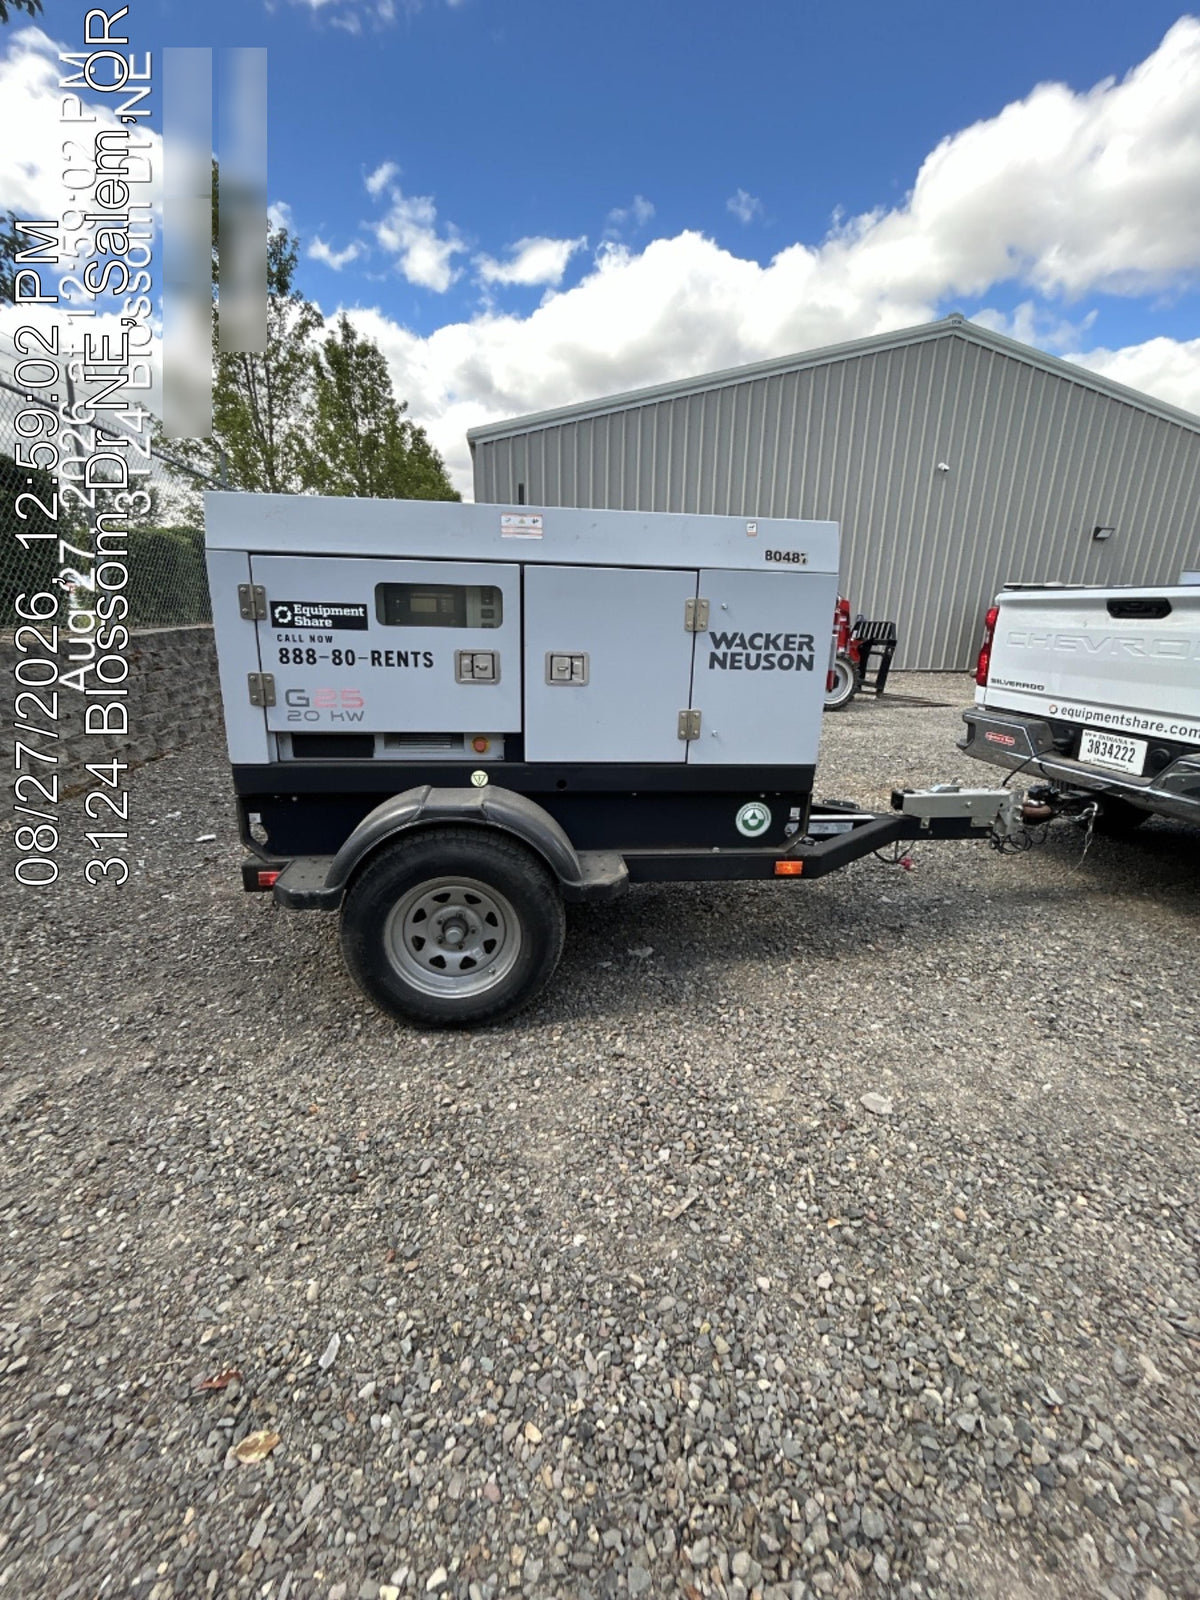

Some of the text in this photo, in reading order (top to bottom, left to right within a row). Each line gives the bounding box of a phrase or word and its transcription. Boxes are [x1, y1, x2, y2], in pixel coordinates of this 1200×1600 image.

[293, 604, 365, 619] Equipment
[294, 617, 333, 628] Share
[277, 634, 333, 644] CALL NOW
[709, 631, 815, 652] WACKER
[1006, 632, 1200, 661] CHEVRO
[278, 648, 434, 669] 888-80-RENTS
[709, 651, 815, 671] NEUSON
[990, 678, 1045, 691] SILVERADO
[285, 688, 364, 708] G25
[287, 710, 320, 722] 20
[1061, 705, 1200, 738] equipmentshare.com
[1087, 738, 1136, 763] 3834222
